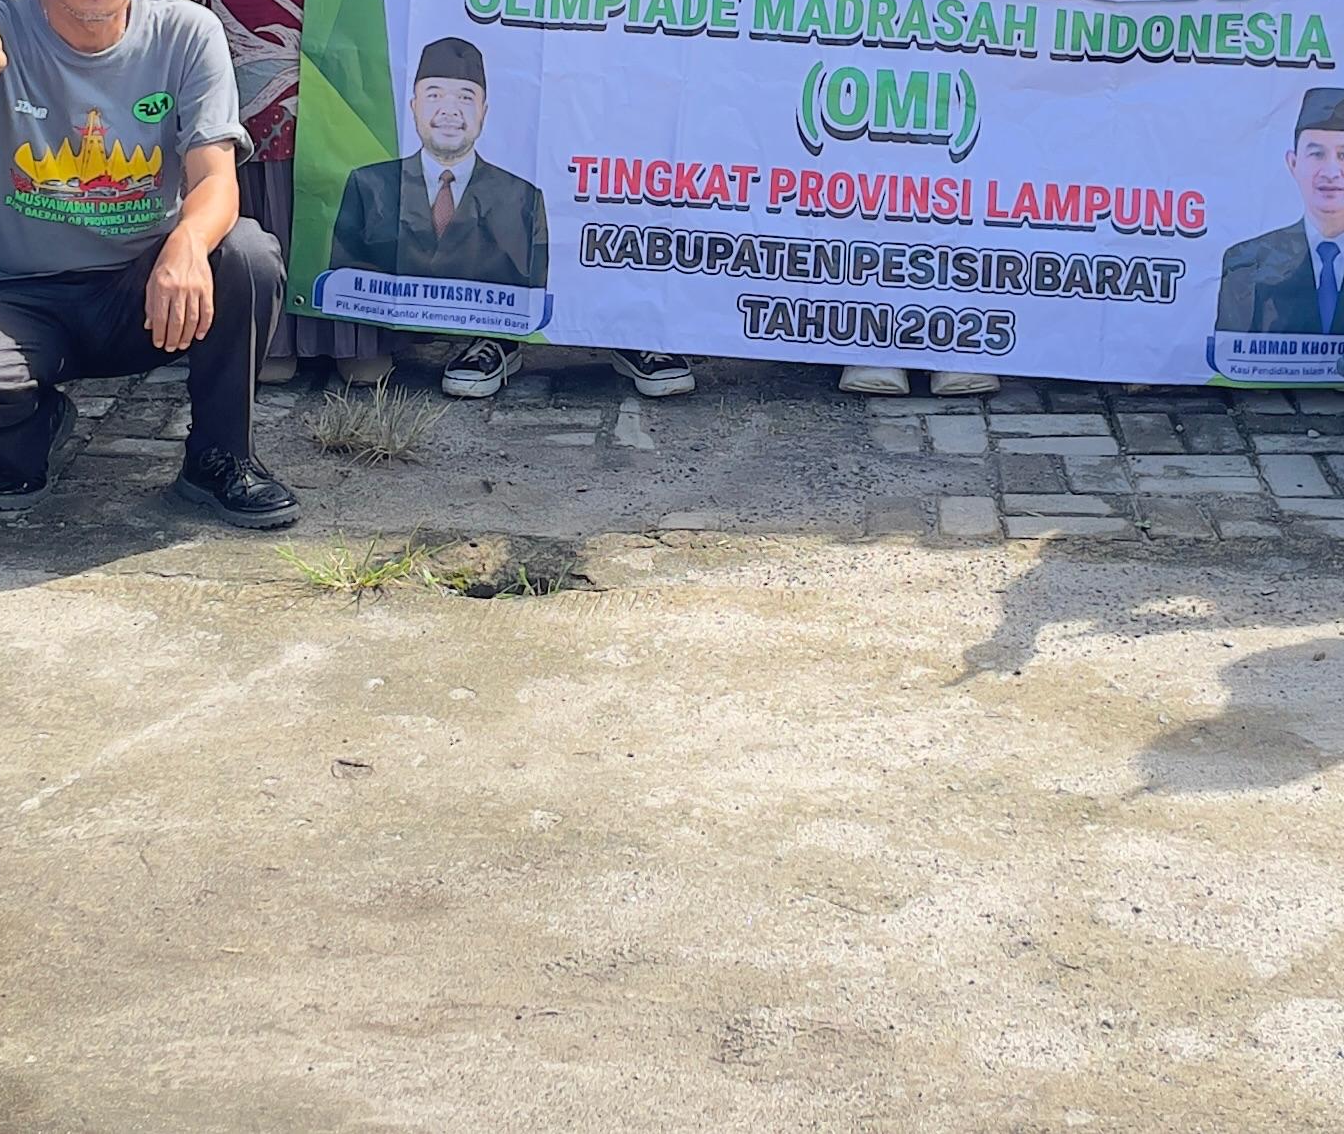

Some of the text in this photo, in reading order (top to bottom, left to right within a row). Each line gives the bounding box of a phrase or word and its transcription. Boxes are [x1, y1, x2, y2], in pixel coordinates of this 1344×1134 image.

[1051, 9, 1336, 69] INDONESIA
[796, 60, 981, 162] (OMI)
[99, 198, 151, 214] DAERAH
[567, 156, 1209, 238] TINGKAT PROVINSI LAMPUNG
[354, 276, 367, 294] H.
[369, 277, 419, 299] HIKMAT
[486, 289, 516, 307] S.Pd
[580, 223, 1185, 303] KABUPATEN PESISIR BARAT
[353, 302, 385, 316] Kepala
[387, 308, 419, 319] Kantor
[421, 311, 467, 325] Kemenag
[469, 314, 503, 326] Pesisir
[504, 317, 529, 331] Barat
[737, 294, 1017, 357] TAHUN 2025
[1233, 339, 1246, 354] H.
[1249, 340, 1298, 356] AHMAD
